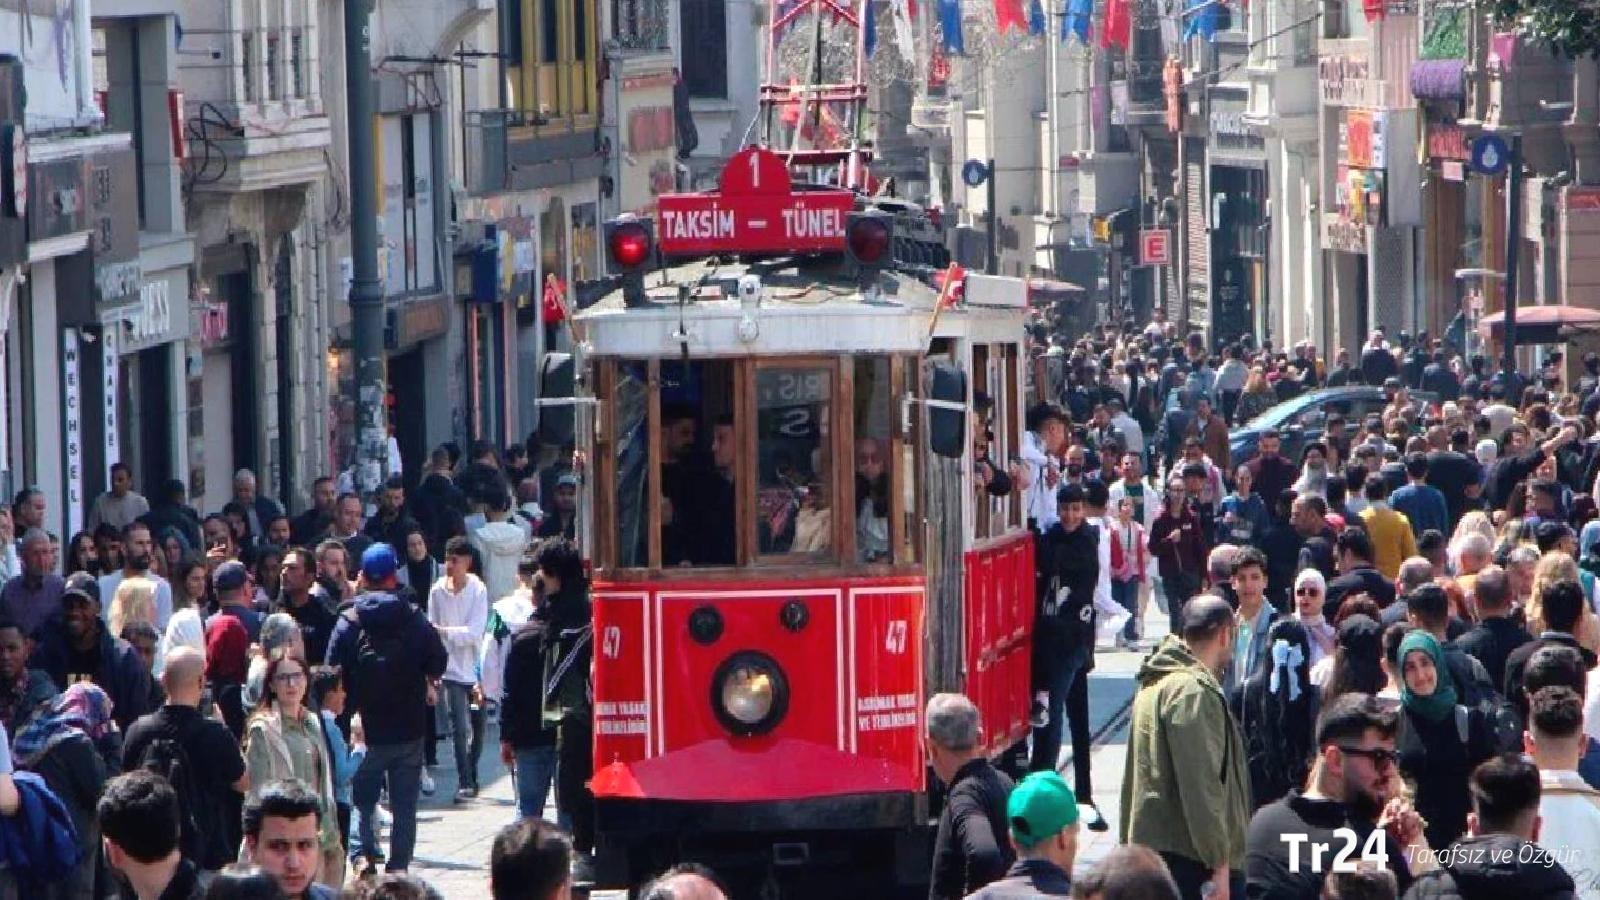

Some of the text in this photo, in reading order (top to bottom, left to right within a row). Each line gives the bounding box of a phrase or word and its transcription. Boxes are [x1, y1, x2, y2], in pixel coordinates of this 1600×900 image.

[749, 152, 760, 188] 1
[662, 203, 735, 239] TAKSİM
[782, 202, 846, 238] TÜNEL
[1149, 237, 1165, 258] E
[66, 351, 80, 503] WECHSEL
[602, 626, 621, 660] 47
[885, 620, 908, 654] 47
